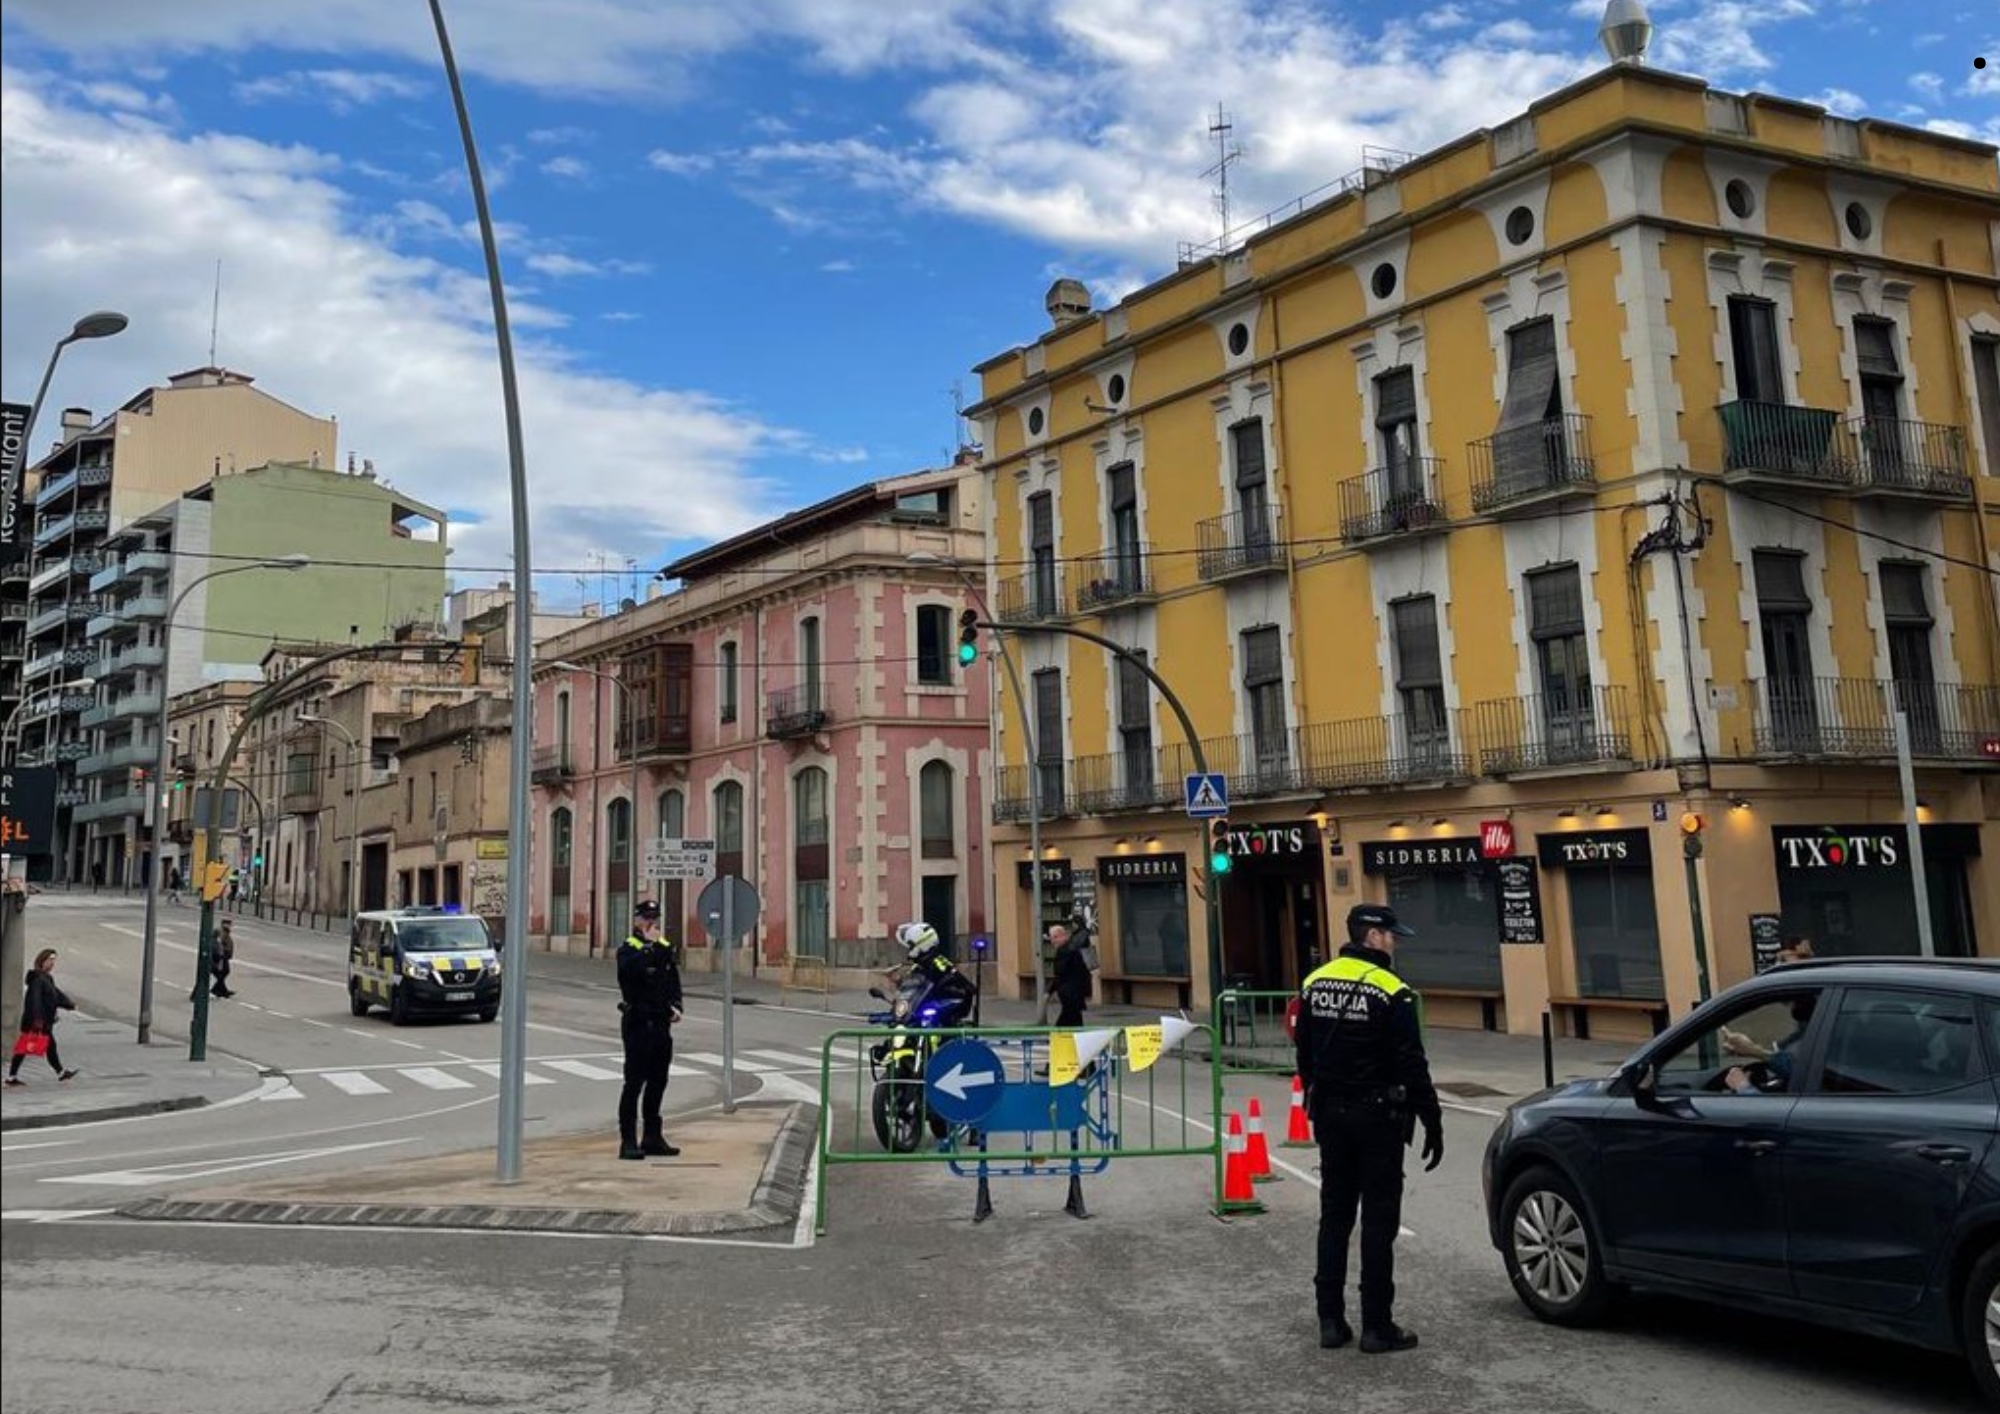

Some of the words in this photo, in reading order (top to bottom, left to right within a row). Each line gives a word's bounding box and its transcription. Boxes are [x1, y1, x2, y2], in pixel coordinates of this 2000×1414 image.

[1485, 825, 1511, 854] illy
[1375, 848, 1478, 865] SIDRERIA
[1562, 840, 1627, 861] TXOT'S
[1781, 834, 1898, 868] TXOT'S
[1107, 860, 1178, 876] SIDRERIA
[1311, 991, 1369, 1013] POLICIA
